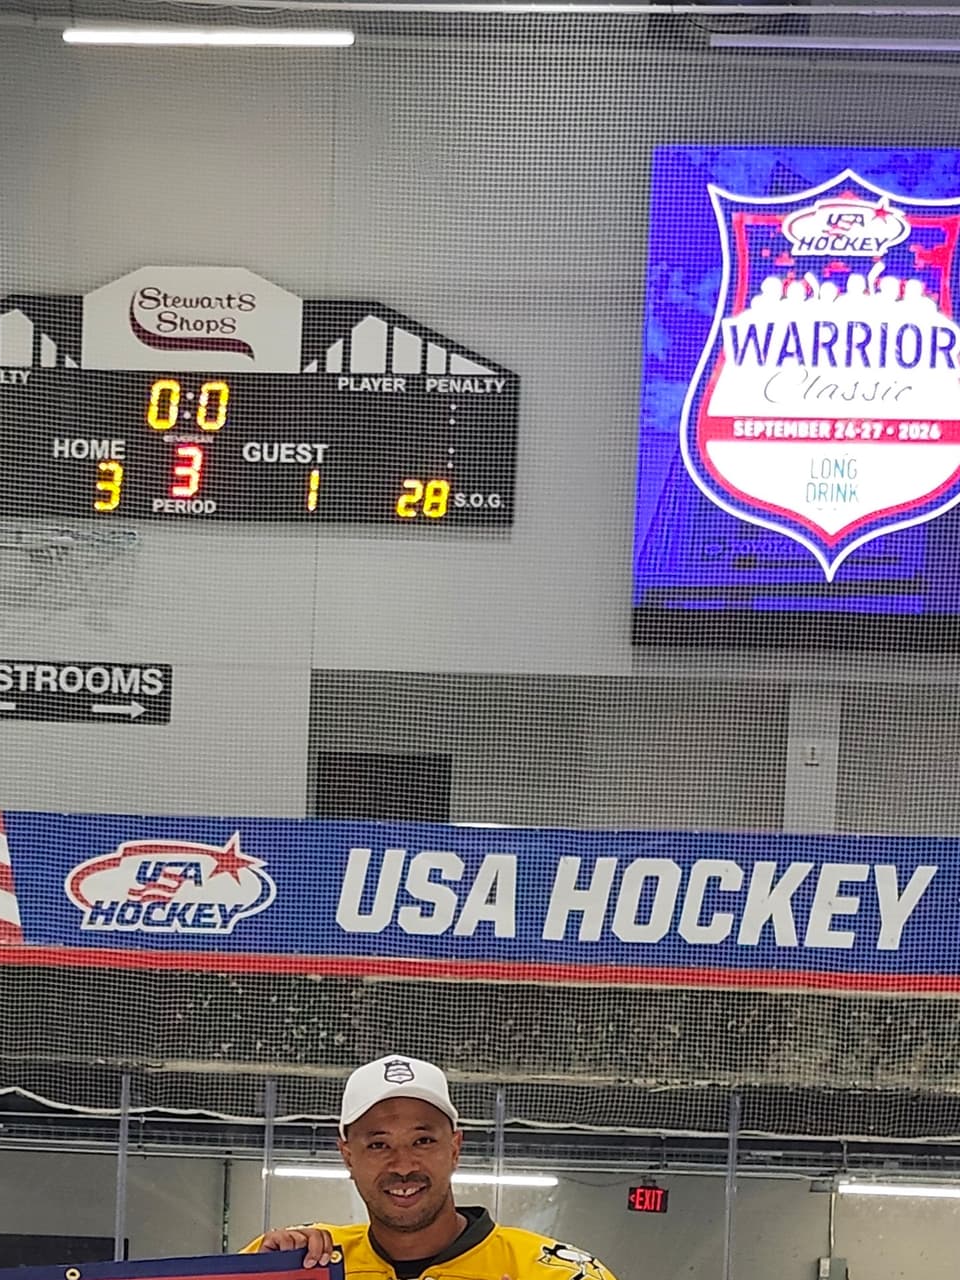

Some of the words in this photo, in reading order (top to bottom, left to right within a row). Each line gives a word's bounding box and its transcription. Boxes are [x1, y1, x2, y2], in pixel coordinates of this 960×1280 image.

[797, 236, 888, 251] HOCKEY
[729, 320, 957, 369] WARRIOR
[338, 377, 407, 393] PLAYER
[425, 378, 506, 394] PENALTY
[733, 420, 831, 439] SEPTEMBER
[898, 422, 943, 441] 2026
[53, 438, 126, 459] HOME
[242, 442, 329, 464] GUEST
[171, 445, 203, 498] 3
[810, 457, 858, 480] LONG
[93, 461, 124, 512] 3
[307, 469, 320, 512] 1
[396, 478, 451, 518] 28
[806, 482, 859, 504] DRINK
[152, 499, 217, 514] PERIOD
[454, 493, 506, 508] S.O.G.
[135, 860, 203, 888] USA
[335, 848, 518, 938] USA
[541, 855, 939, 951] HOCKEY
[87, 900, 243, 929] HOCKEY
[634, 1188, 664, 1211] EXIT
